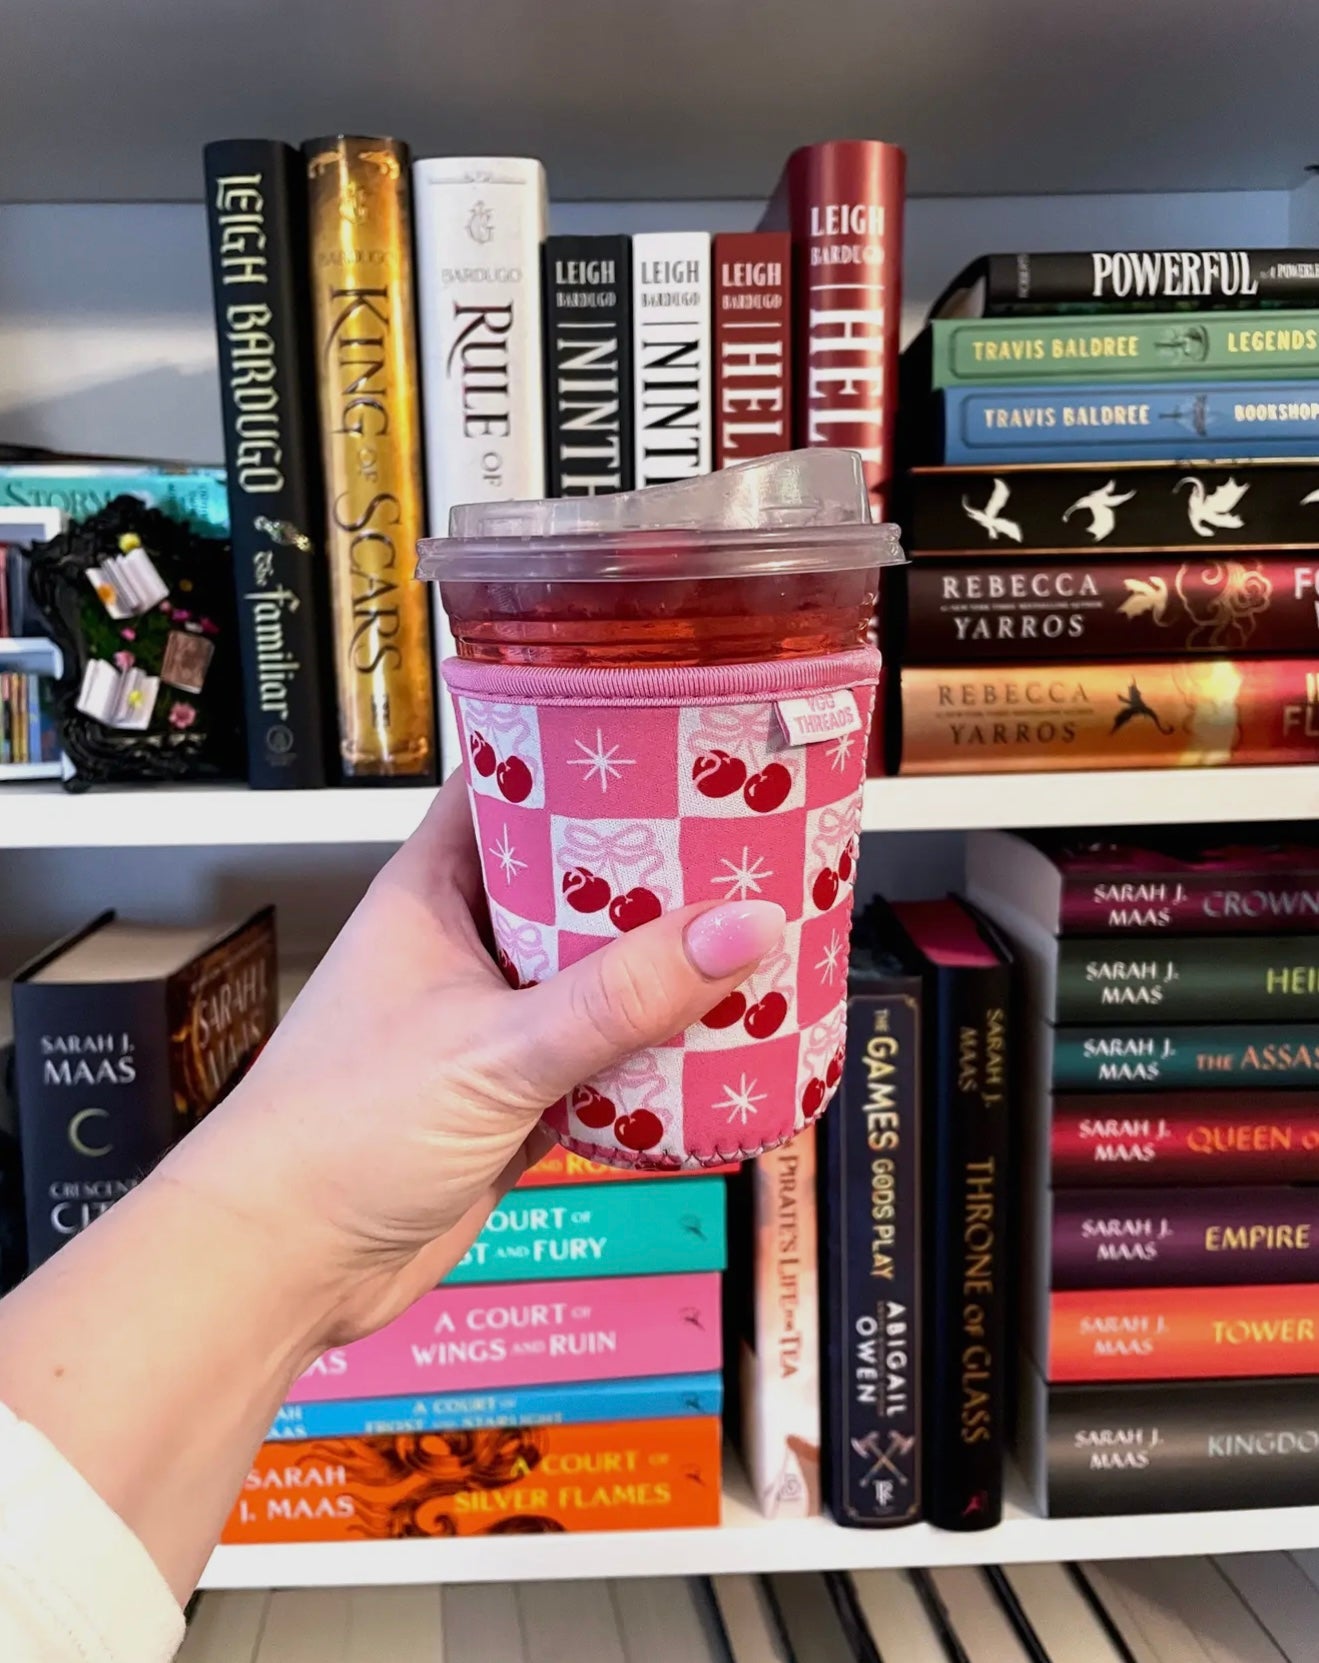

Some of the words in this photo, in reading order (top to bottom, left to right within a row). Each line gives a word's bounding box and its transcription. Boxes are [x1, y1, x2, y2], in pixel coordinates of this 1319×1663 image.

[216, 173, 268, 285] LEIGH
[811, 204, 885, 236] LEIGH
[811, 244, 885, 266] BARDUGO
[441, 267, 523, 285] BARDUGO
[555, 260, 616, 285] LEIGH
[641, 260, 700, 285] LEIGH
[721, 262, 783, 287] LEIGH
[1092, 251, 1258, 297] POWERFUL
[972, 340, 1045, 361] TRAVIS
[1050, 336, 1139, 358] BALDREE
[1227, 329, 1318, 352] LEGENDS
[324, 286, 390, 438] KING
[226, 302, 284, 493] BARDUGO
[446, 300, 514, 438] RULE
[480, 452, 502, 487] OF
[809, 308, 885, 464] HEL
[721, 341, 784, 468] HEL
[984, 407, 1057, 428] TRAVIS
[1062, 404, 1151, 426] BALDREE
[334, 492, 402, 675] SCARS
[941, 572, 1099, 599] REBECCA
[953, 614, 1085, 640] YARROS
[244, 584, 300, 720] familiar
[937, 681, 1089, 706] REBECCA
[794, 706, 855, 734] THREADS
[949, 721, 1077, 745] YARROS
[1093, 883, 1166, 905] SARAH
[1172, 883, 1188, 906] J.
[1108, 908, 1172, 927] MAAS
[1085, 961, 1157, 982] SARAH
[1164, 961, 1180, 983] J.
[1101, 984, 1164, 1005] MAAS
[874, 1008, 890, 1032] THE
[41, 1033, 114, 1055] SARAH
[985, 1008, 1005, 1084] SARAH
[1083, 1038, 1154, 1059] SARAH
[1160, 1038, 1176, 1059] J.
[1196, 1054, 1234, 1070] THE
[44, 1056, 137, 1086] MAAS
[957, 1026, 979, 1093] MAAS
[1098, 1061, 1160, 1081] MAAS
[862, 1036, 900, 1151] GAMES
[1078, 1119, 1150, 1140] SARAH
[1155, 1119, 1172, 1141] J.
[1186, 1125, 1292, 1155] QUEEN
[1094, 1143, 1156, 1163] MAAS
[49, 1179, 138, 1200] CRESCEN
[871, 1158, 896, 1220] GODS
[486, 1207, 567, 1233] OURT
[570, 1210, 592, 1225] OF
[964, 1156, 996, 1297] THRONE
[1081, 1219, 1151, 1239] SARAH
[1157, 1218, 1174, 1240] J.
[1205, 1224, 1312, 1251] EMPIRE
[496, 1244, 530, 1259] AND
[533, 1236, 608, 1263] FURY
[870, 1224, 896, 1281] PLAY
[1096, 1241, 1158, 1261] MAAS
[778, 1257, 800, 1307] LIFE
[434, 1311, 456, 1333] A
[466, 1303, 567, 1330] COURT
[962, 1304, 986, 1338] OF
[1079, 1316, 1150, 1335] SARAH
[1154, 1315, 1169, 1334] J.
[1212, 1319, 1316, 1345] TOWER
[411, 1339, 507, 1367] WINGS
[511, 1340, 546, 1356] AND
[549, 1330, 617, 1357] RUIN
[779, 1330, 801, 1379] TEA
[855, 1316, 879, 1403] OWEN
[886, 1300, 908, 1418] ABIGAIL
[1093, 1337, 1155, 1357] MAAS
[412, 1400, 428, 1416] A
[432, 1397, 496, 1415] COURT
[960, 1345, 992, 1445] GLASS
[1073, 1429, 1144, 1449] SARAH
[1150, 1428, 1165, 1449] J.
[510, 1455, 530, 1476] A
[541, 1450, 638, 1473] COURT
[1089, 1451, 1150, 1471] MAAS
[243, 1465, 347, 1491] SARAH
[266, 1495, 355, 1520] MAAS
[454, 1486, 549, 1514] SILVER
[558, 1482, 672, 1508] FLAMES
